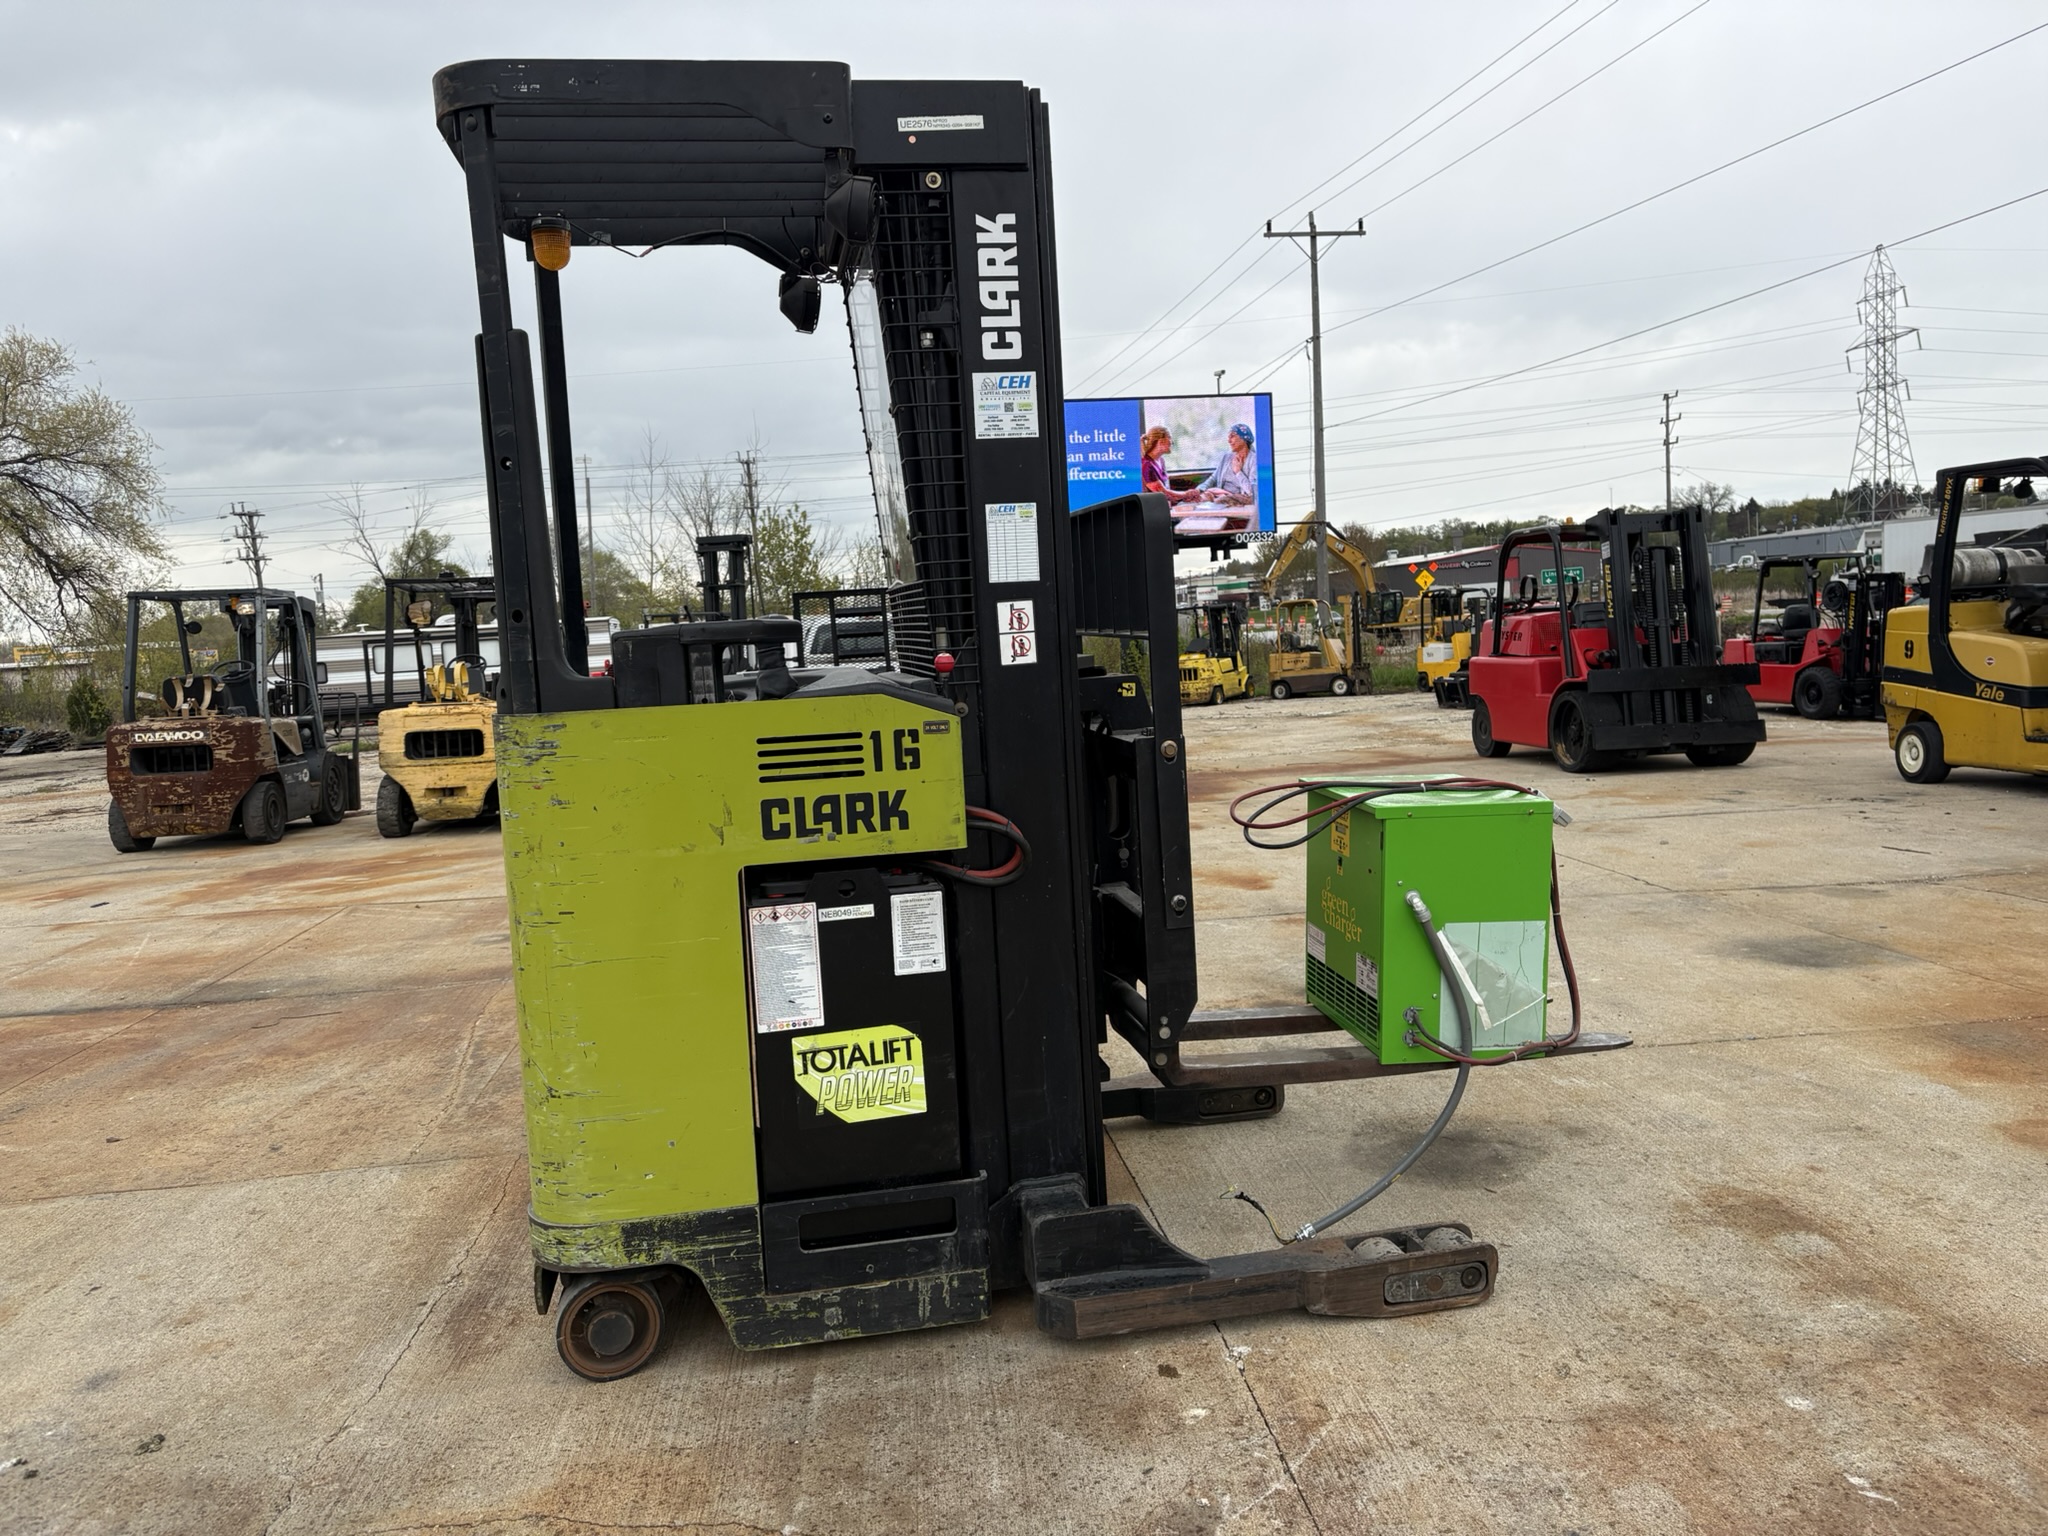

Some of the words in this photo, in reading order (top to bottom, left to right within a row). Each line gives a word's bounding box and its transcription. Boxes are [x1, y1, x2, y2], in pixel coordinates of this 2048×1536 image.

[900, 120, 933, 129] UE2576
[975, 213, 1023, 361] CLARK
[998, 375, 1031, 389] CEH
[1069, 430, 1091, 444] the
[1094, 428, 1127, 443] little
[1067, 453, 1084, 462] an
[1088, 447, 1125, 462] make
[1068, 467, 1126, 480] fference.
[998, 505, 1016, 513] CEH
[1938, 501, 1949, 537] eracitor
[1235, 531, 1274, 543] 002332
[1604, 565, 1614, 618] HYSTER
[1501, 631, 1522, 642] YSTER
[1975, 682, 2005, 702] Yale
[134, 730, 205, 742] DAEWOO
[760, 789, 910, 841] CLARK
[1321, 888, 1349, 917] green
[821, 908, 853, 919] NE8049
[1324, 904, 1362, 942] charger
[797, 1034, 916, 1076] TOTALIFT
[816, 1064, 914, 1116] POWER
